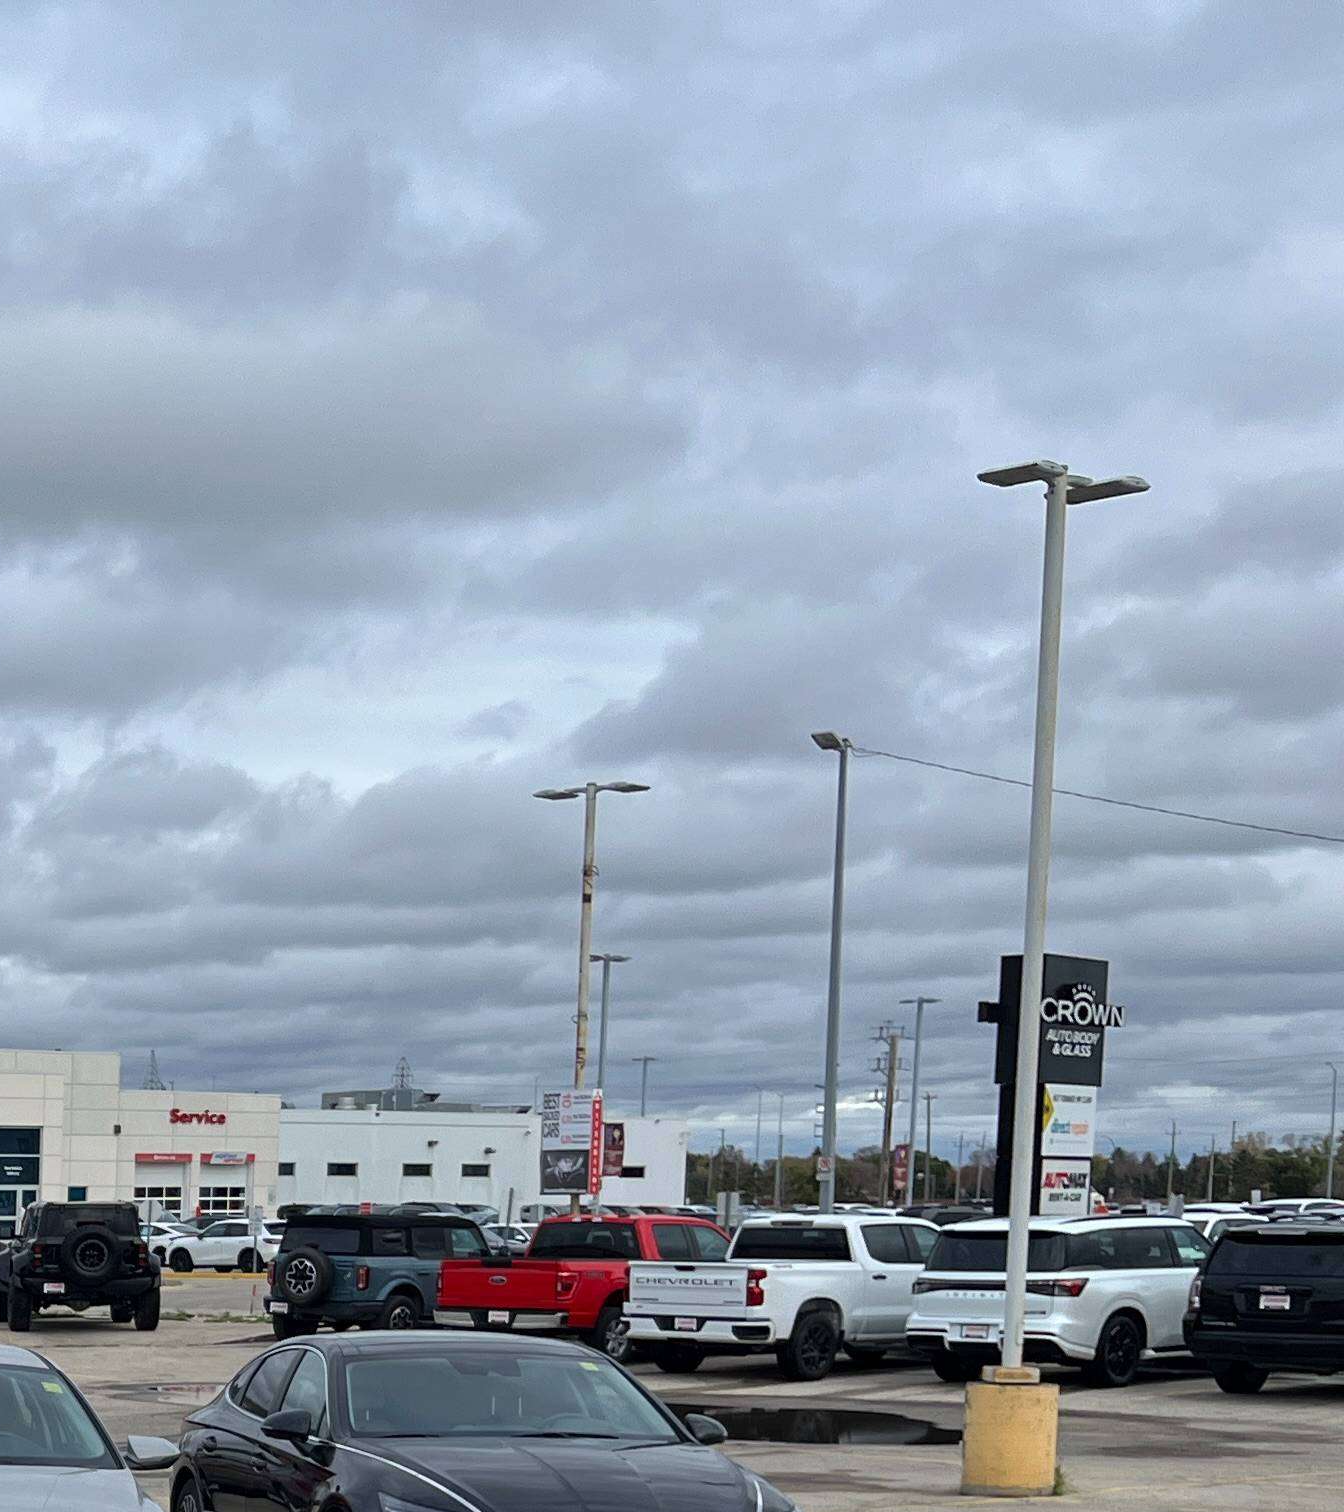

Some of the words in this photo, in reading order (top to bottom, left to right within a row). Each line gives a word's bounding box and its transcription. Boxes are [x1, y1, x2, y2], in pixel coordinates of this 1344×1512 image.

[1040, 997, 1126, 1027] CROWN
[169, 1108, 226, 1125] Service
[636, 1276, 734, 1288] CHEVROLET
